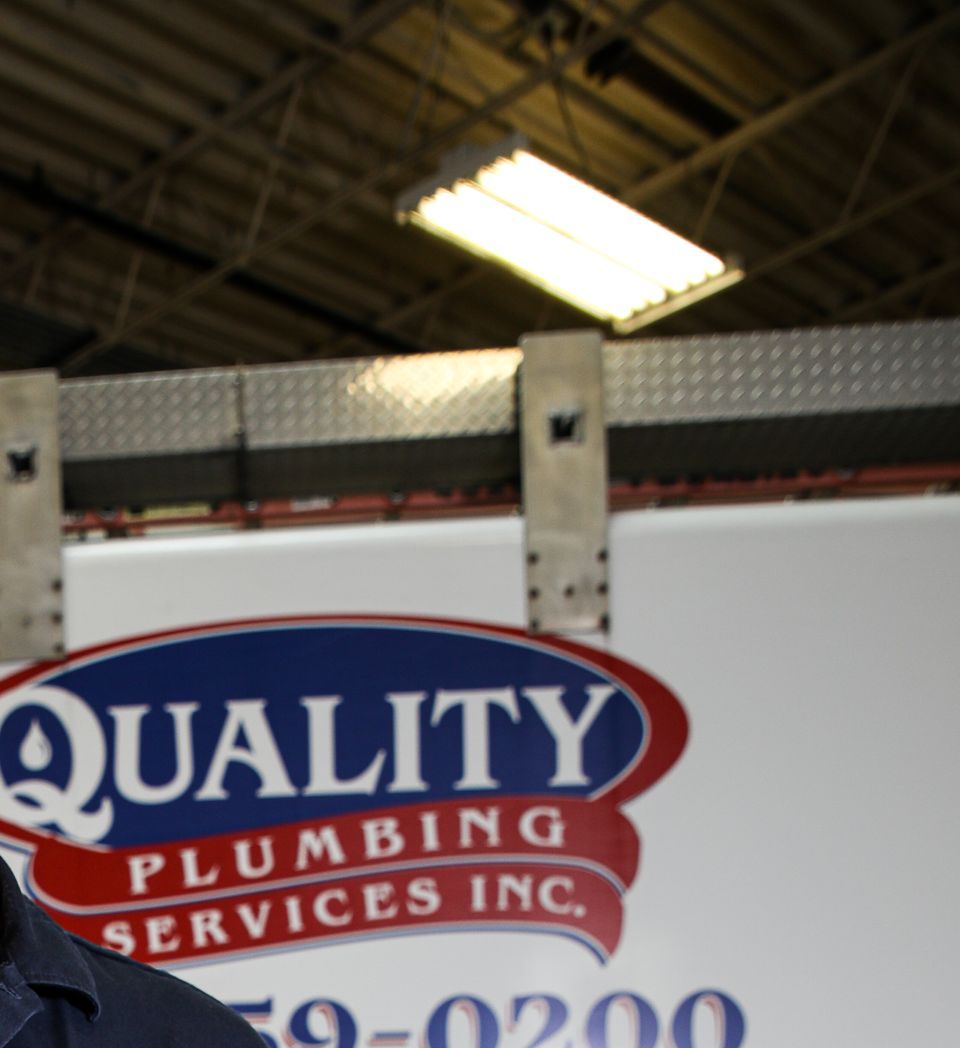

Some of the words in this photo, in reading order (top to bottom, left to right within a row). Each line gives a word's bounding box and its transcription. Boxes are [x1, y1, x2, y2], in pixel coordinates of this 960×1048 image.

[127, 806, 566, 895] PLUMBING
[102, 877, 440, 957] SERVICES
[470, 875, 586, 918] INC.
